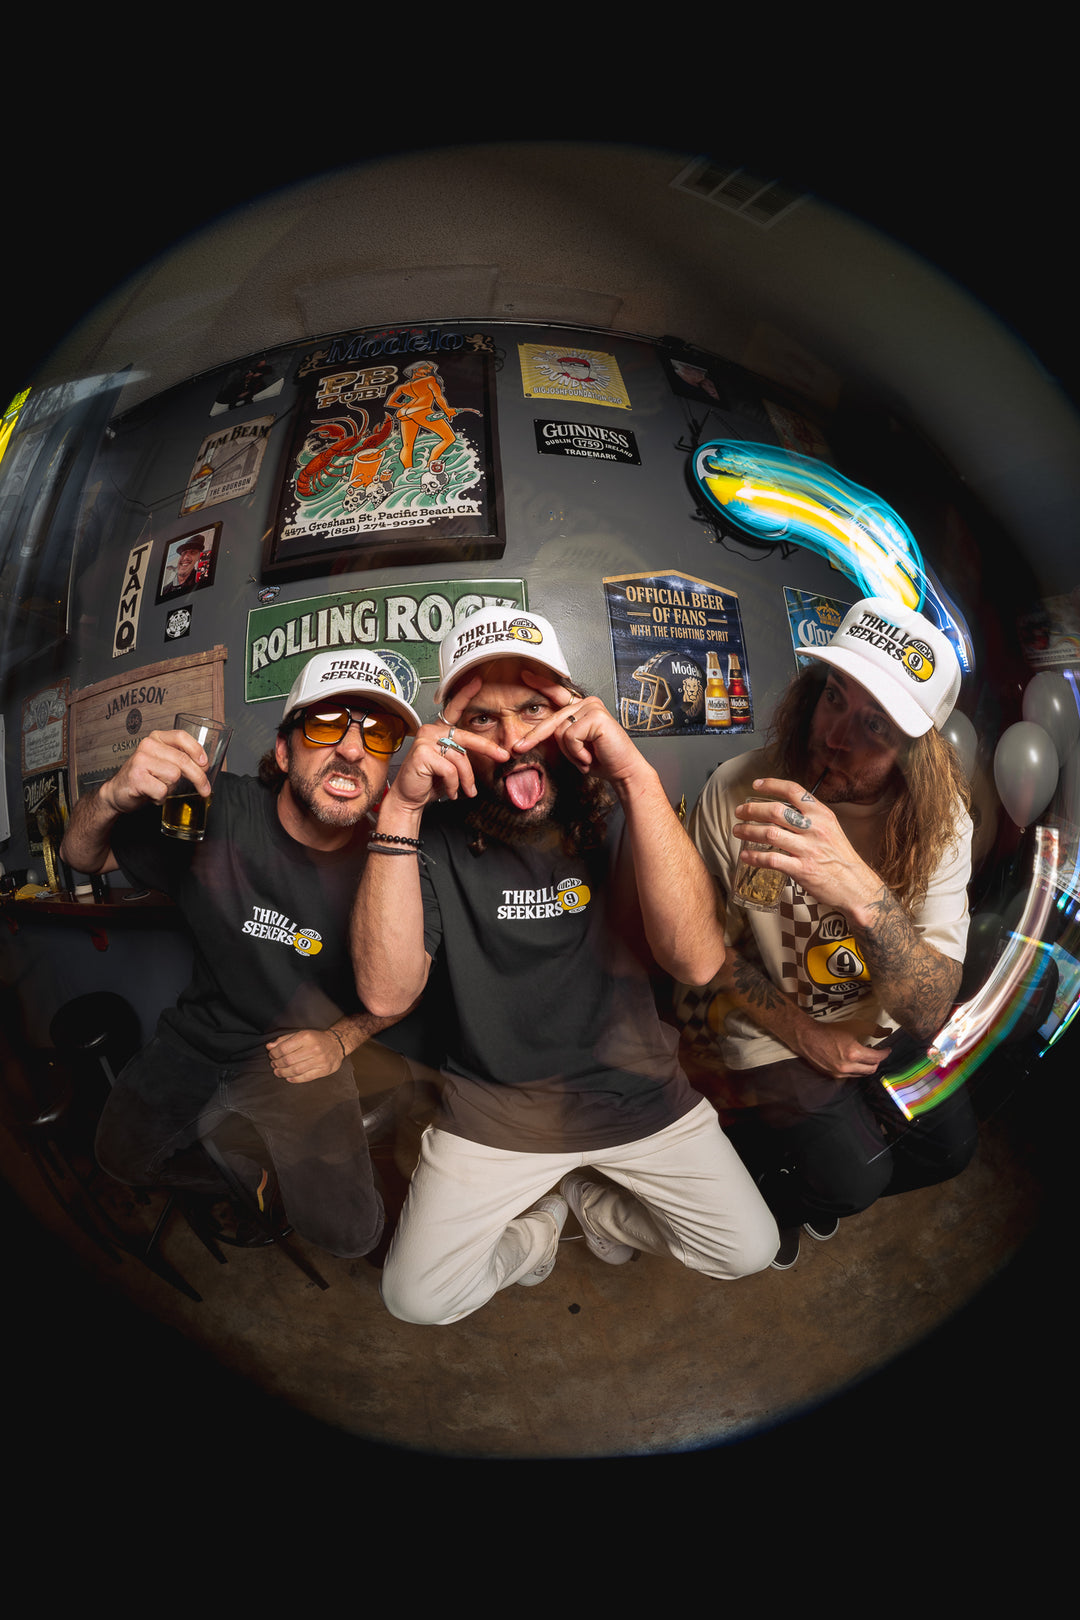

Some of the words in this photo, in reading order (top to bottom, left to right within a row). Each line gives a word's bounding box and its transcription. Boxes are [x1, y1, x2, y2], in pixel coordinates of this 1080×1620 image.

[326, 329, 463, 363] Modelo
[315, 365, 399, 399] PB
[317, 384, 388, 410] PUB!
[197, 432, 230, 462] JIM
[231, 425, 271, 440] BEAM
[542, 423, 629, 448] GUINNESS
[545, 438, 571, 446] DUBLIN
[578, 438, 600, 447] 1759
[605, 443, 633, 458] IRELAND
[564, 448, 617, 460] TRADEMARK
[221, 477, 252, 492] BOURBON
[284, 526, 307, 537] 4471
[309, 516, 355, 530] Gresham
[358, 513, 377, 523] St,
[378, 510, 418, 521] Pacific
[420, 506, 456, 517] Beach
[457, 505, 476, 514] CA
[330, 525, 360, 537] (858)
[363, 518, 424, 530] 274-9090
[116, 545, 149, 650] JAMO
[625, 585, 690, 607] OFFICIAL
[691, 592, 726, 611] BEER
[652, 606, 671, 624] OF
[672, 608, 707, 627] FANS
[251, 600, 379, 674] ROLLING
[385, 593, 518, 643] ROC
[457, 620, 512, 647] THRILL
[521, 629, 529, 639] 9
[629, 623, 651, 637] WITH
[652, 625, 669, 638] THE
[670, 626, 705, 641] FIGHTING
[706, 629, 729, 643] SPIRIT
[797, 619, 835, 647] Cor
[846, 625, 906, 661] SEEKERS
[858, 613, 909, 649] THRILL
[452, 633, 515, 663] SEEKERS
[330, 660, 381, 676] THRILL
[911, 655, 920, 667] 9
[320, 670, 381, 687] SEEKERS
[105, 686, 167, 720] JAMESON
[502, 885, 559, 905] THRILL
[566, 893, 576, 903] 9
[252, 905, 298, 936] THRILL
[497, 901, 564, 920] SEEKERS
[241, 920, 297, 946] SEEKERS
[300, 939, 309, 948] 9
[837, 951, 856, 973] 9
